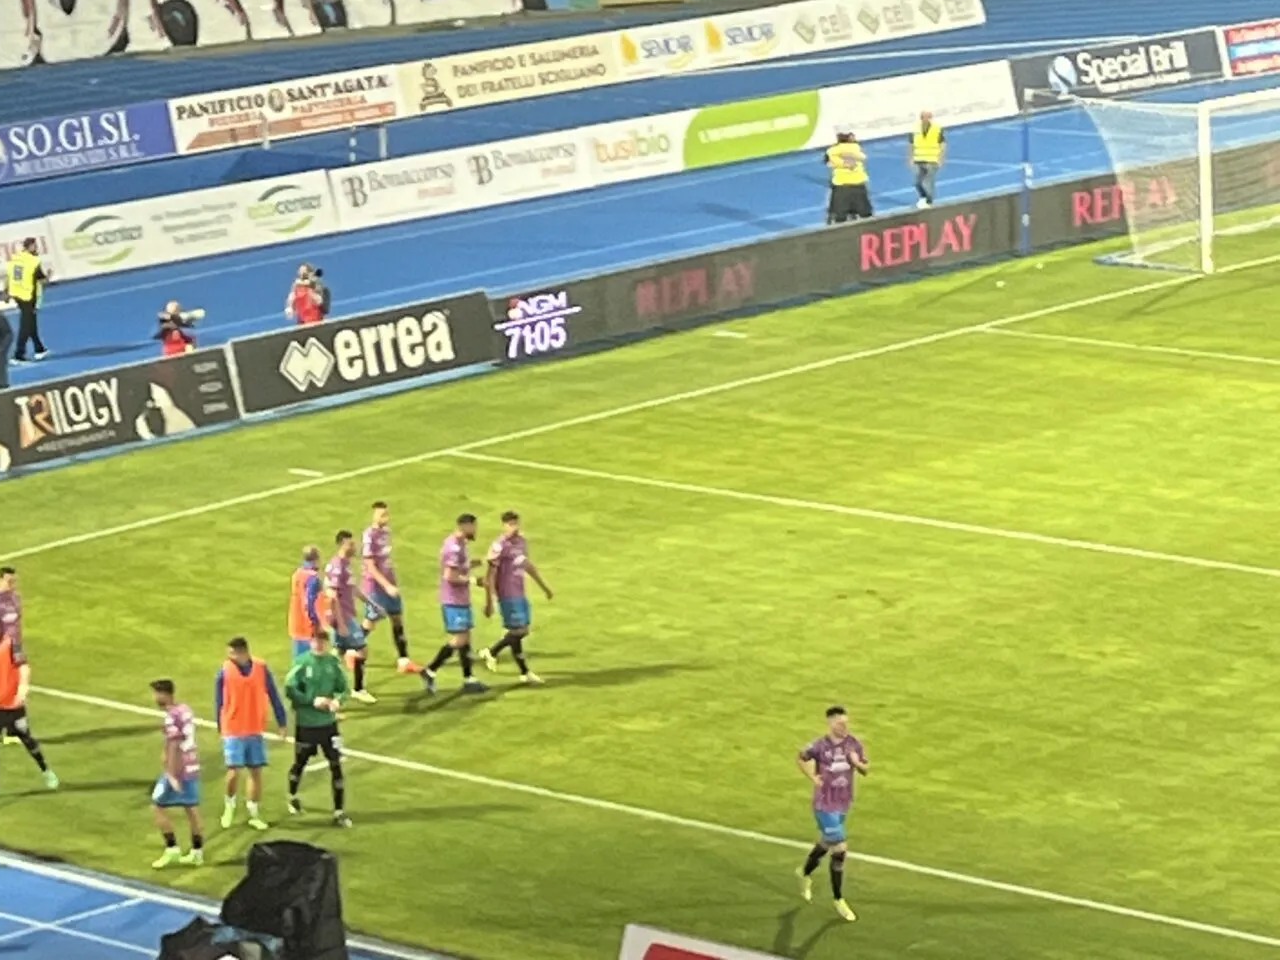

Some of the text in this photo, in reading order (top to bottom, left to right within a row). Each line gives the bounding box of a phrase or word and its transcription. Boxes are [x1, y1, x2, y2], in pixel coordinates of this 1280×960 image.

[1076, 46, 1149, 84] Special
[175, 93, 266, 121] PANIFICIO
[858, 213, 978, 273] REPLAY
